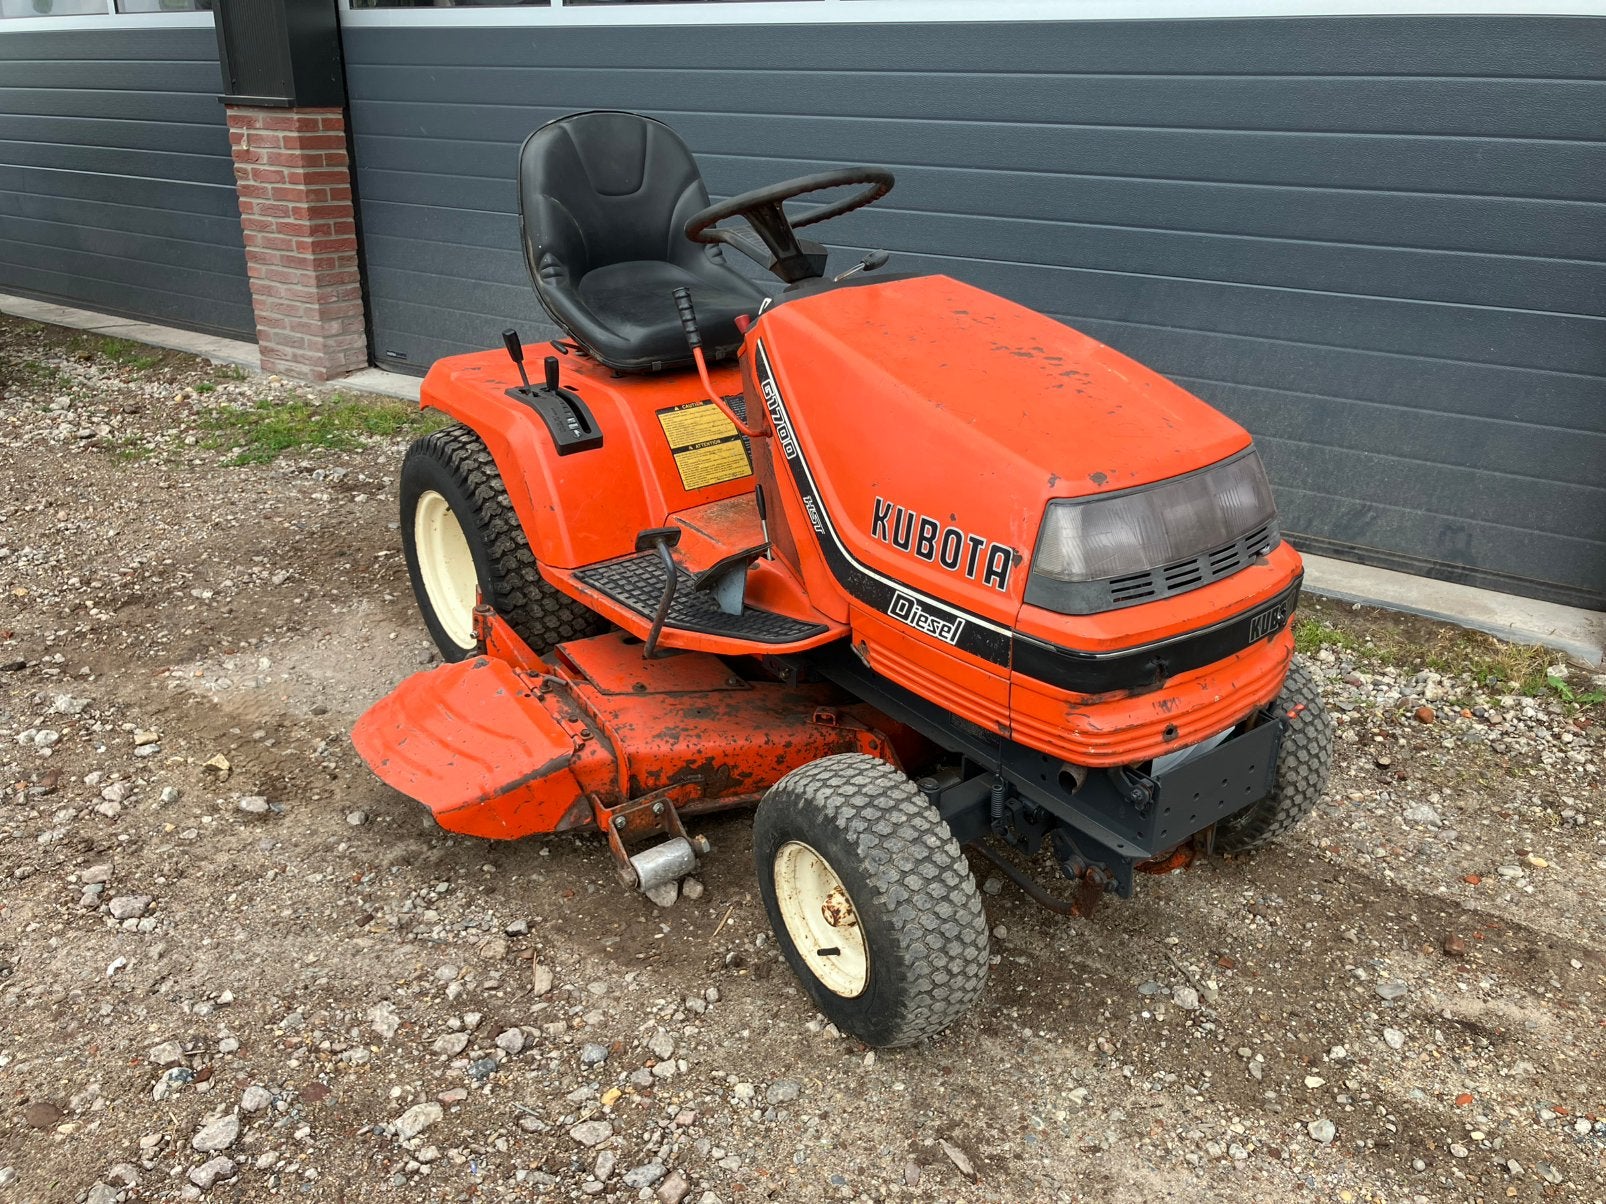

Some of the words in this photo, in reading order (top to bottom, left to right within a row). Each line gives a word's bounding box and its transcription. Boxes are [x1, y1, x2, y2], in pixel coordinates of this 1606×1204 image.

[681, 401, 704, 409] CAUTION
[761, 378, 797, 460] G1700
[695, 440, 721, 449] ATTENTION
[803, 495, 826, 535] HST
[870, 495, 1014, 593] KUBOTA
[887, 590, 966, 645] Diesel
